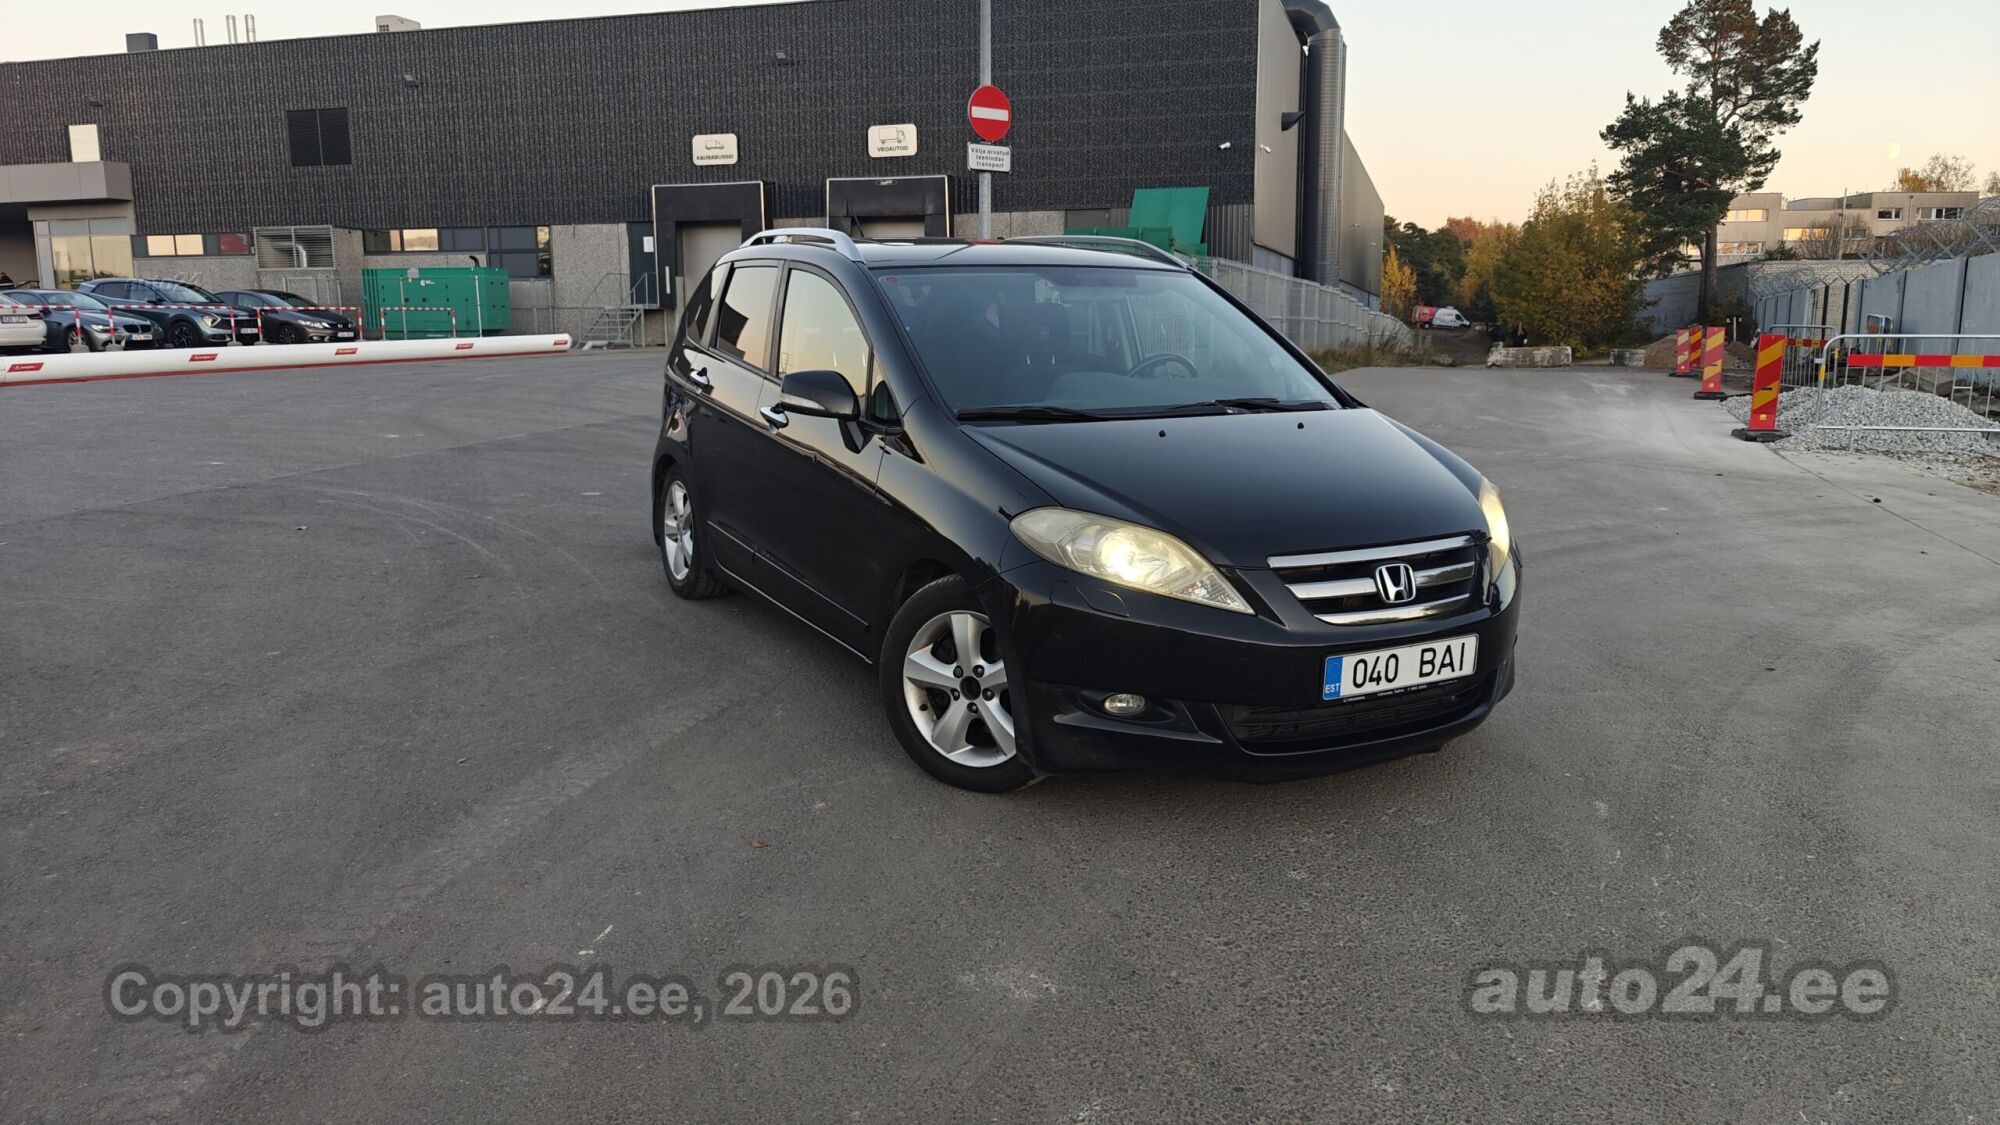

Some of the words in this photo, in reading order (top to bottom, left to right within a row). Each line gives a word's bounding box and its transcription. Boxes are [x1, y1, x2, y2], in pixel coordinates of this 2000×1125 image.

[1352, 653, 1399, 688] 040
[1419, 642, 1465, 678] BAI
[1325, 683, 1340, 694] EST
